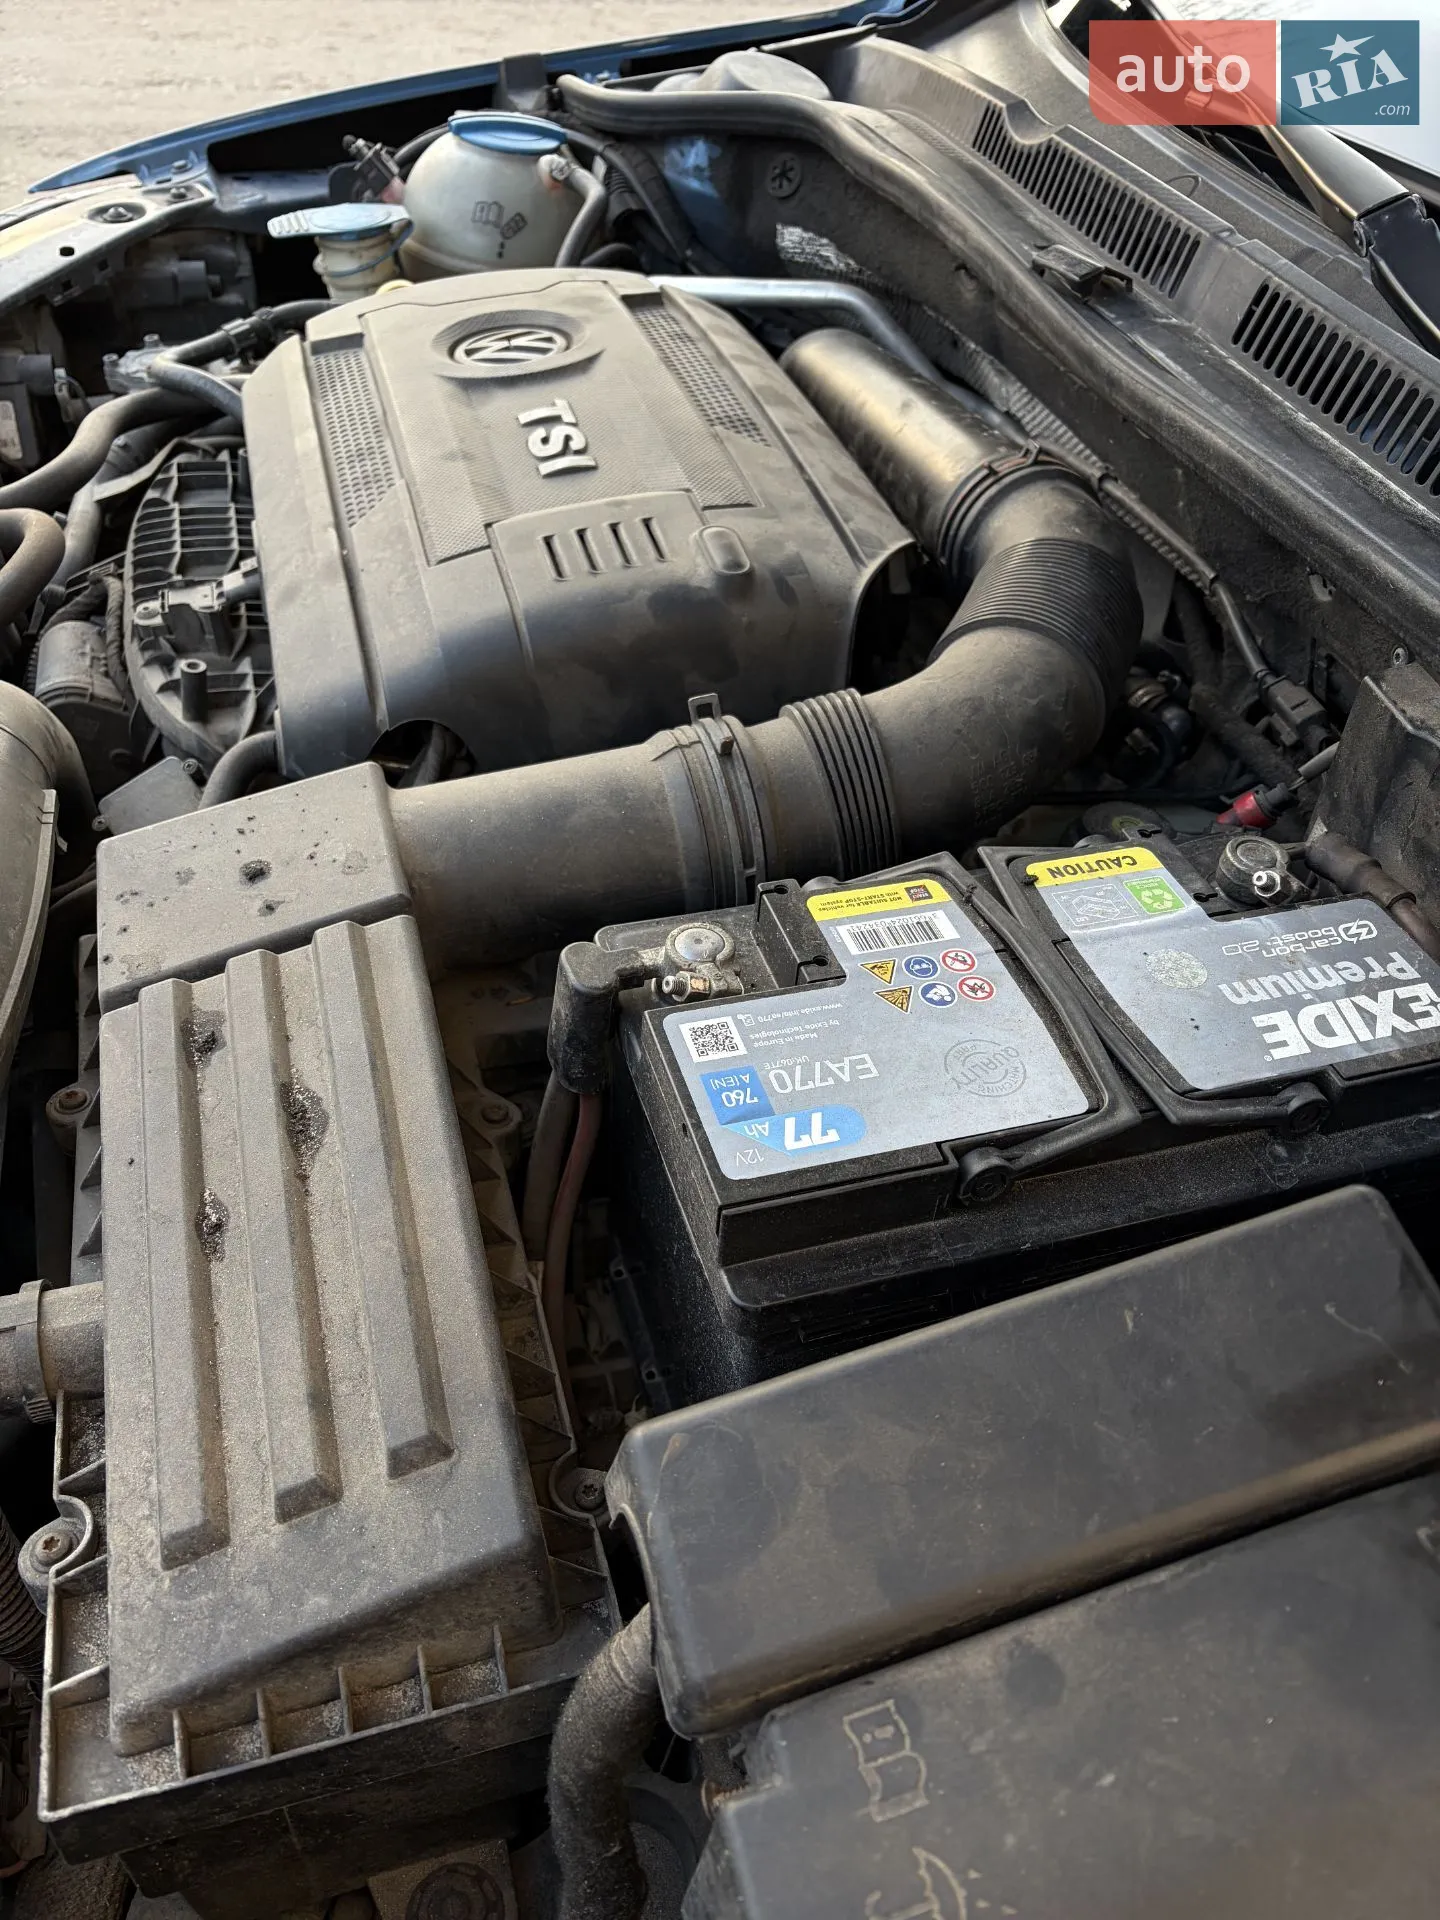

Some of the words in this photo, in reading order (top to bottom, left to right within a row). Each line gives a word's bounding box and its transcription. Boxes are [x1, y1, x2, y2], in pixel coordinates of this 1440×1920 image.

[517, 398, 597, 478] TSI
[1047, 855, 1137, 879] CAUTION
[844, 893, 884, 904] START-STOP
[856, 898, 888, 907] SUITABLE
[1262, 936, 1342, 958] carbon
[1217, 951, 1422, 1005] Premium
[749, 1025, 804, 1040] Technologies
[804, 1021, 828, 1029] Exide
[753, 1037, 784, 1048] Europe
[794, 1032, 818, 1040] Made
[768, 1054, 880, 1094] EA770
[721, 1087, 759, 1107] 760
[744, 1121, 769, 1137] Ah
[784, 1112, 840, 1150] 77
[735, 1147, 765, 1166] 12V
